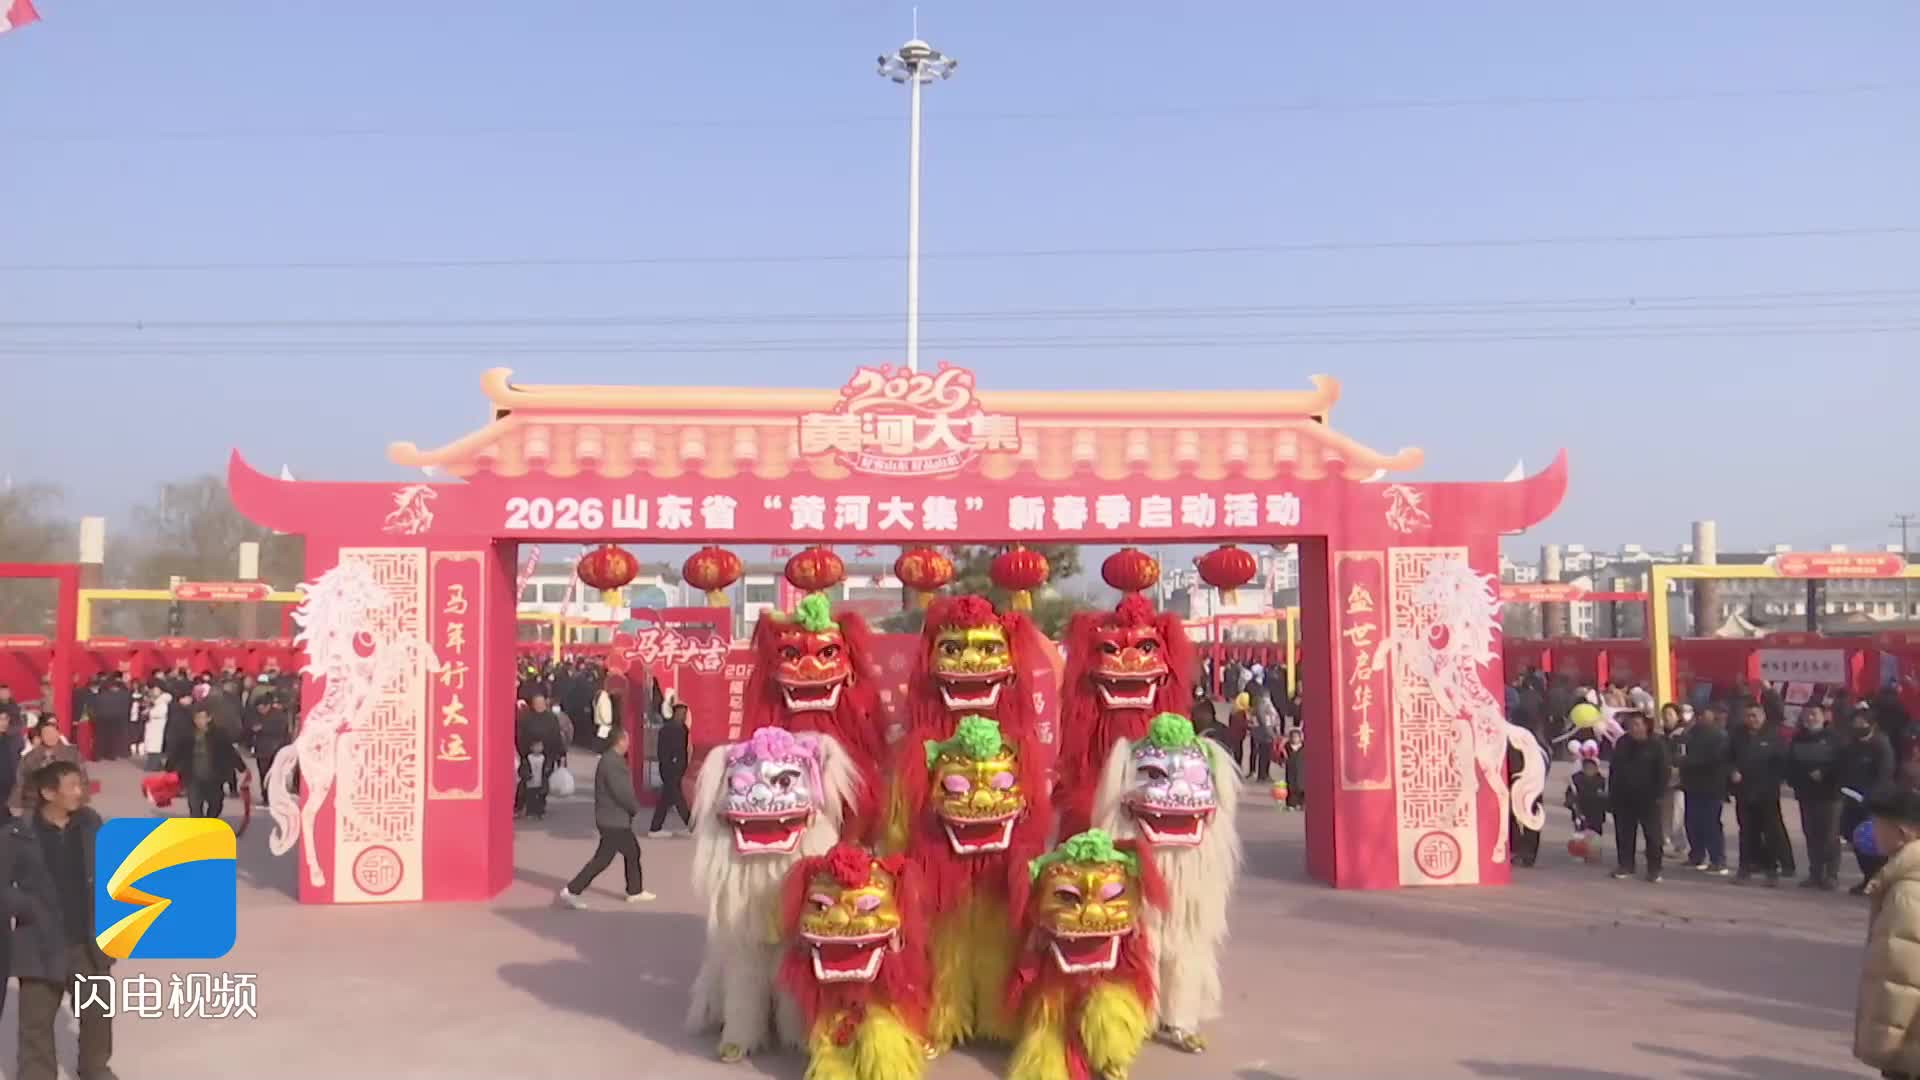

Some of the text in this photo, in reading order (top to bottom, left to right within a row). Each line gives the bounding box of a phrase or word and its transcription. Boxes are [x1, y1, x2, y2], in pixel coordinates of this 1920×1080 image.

[851, 368, 970, 413] 2026
[801, 412, 1020, 454] 黄河大集
[436, 583, 473, 761] 马年行大运
[624, 629, 727, 672] 马年大吉
[1343, 583, 1377, 757] 盛世启华章
